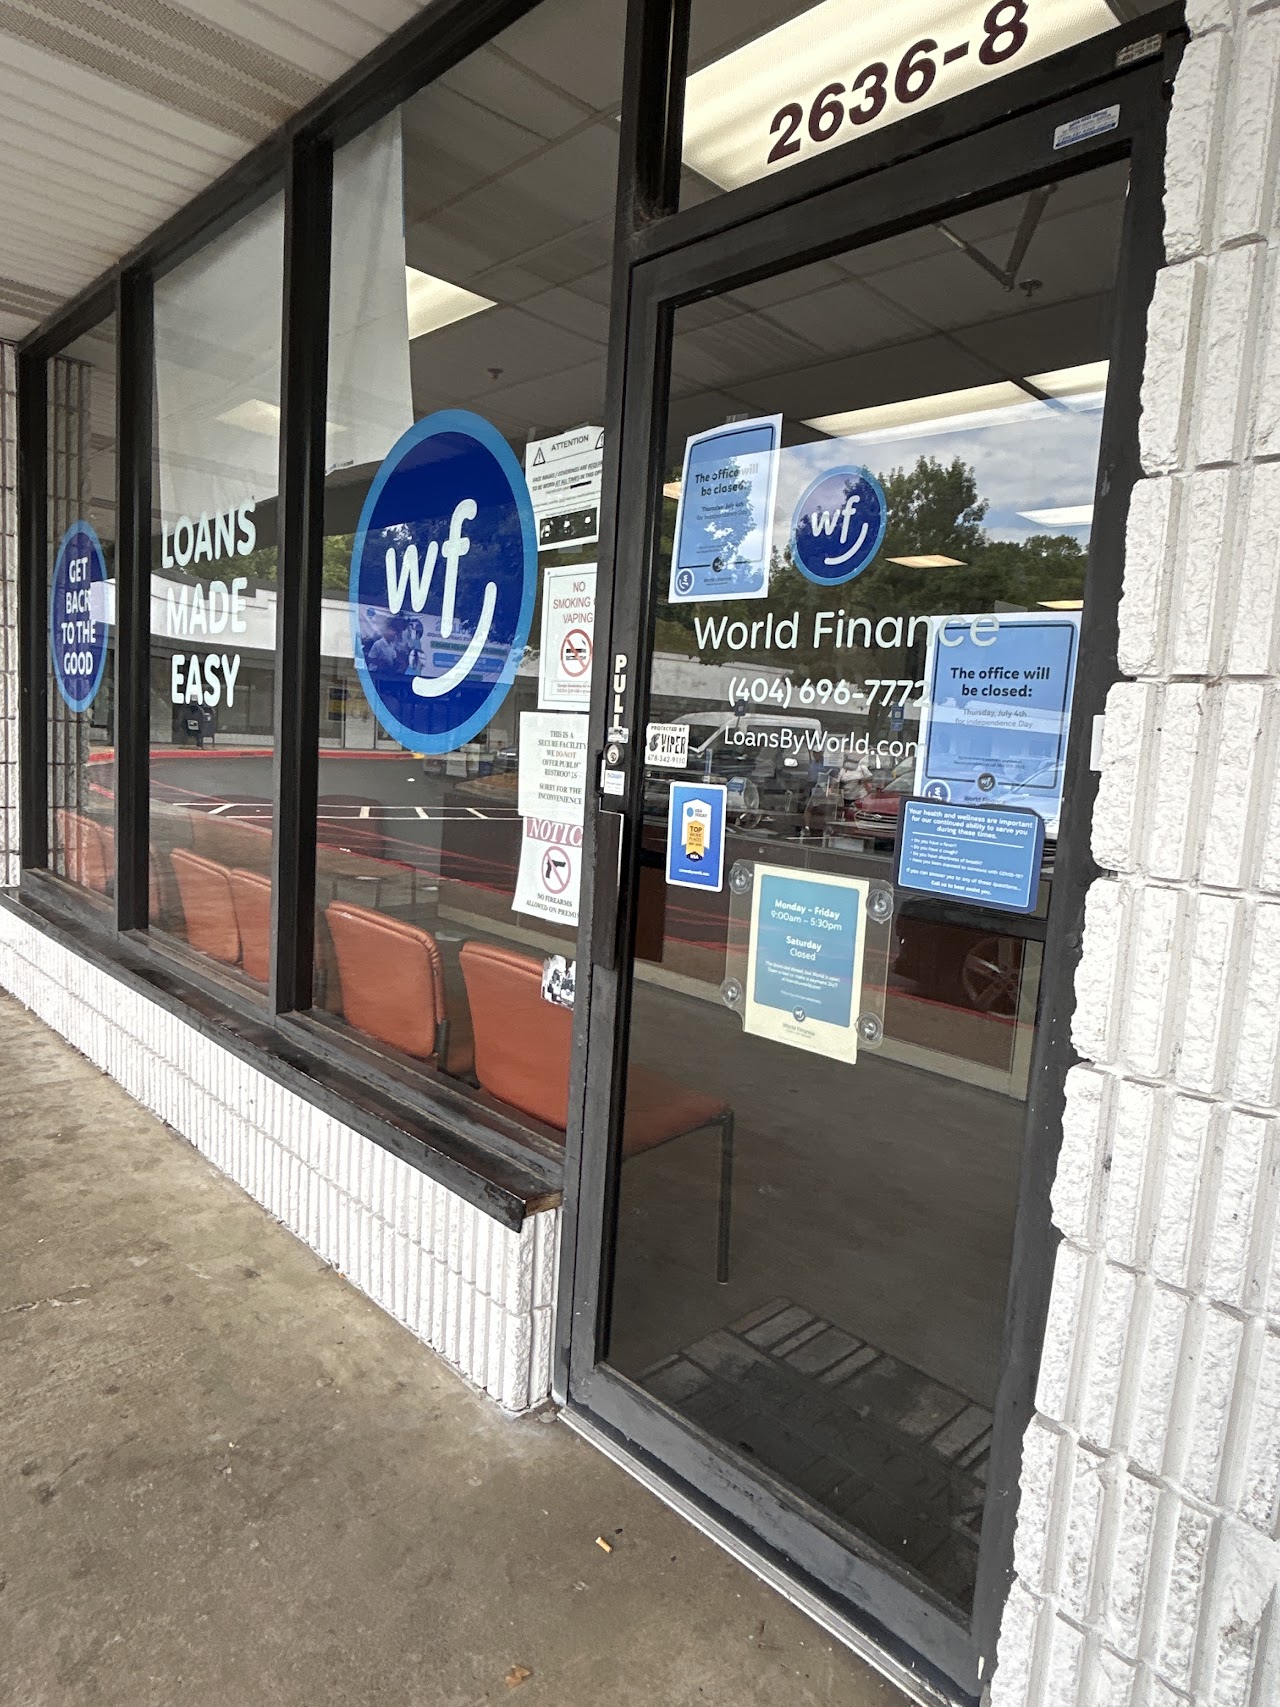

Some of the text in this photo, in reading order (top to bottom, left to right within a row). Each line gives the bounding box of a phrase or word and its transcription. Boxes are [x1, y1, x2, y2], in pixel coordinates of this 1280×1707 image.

[767, 0, 1028, 164] 2636-8
[551, 434, 589, 452] ATTENTION
[695, 464, 758, 483] The office will
[161, 498, 256, 568] LOANS
[69, 557, 88, 583] GET
[573, 581, 585, 592] NO
[66, 589, 92, 614] BACK
[167, 577, 248, 635] MADE
[553, 596, 591, 609] SMOKING
[563, 612, 593, 624] VAPING
[61, 619, 97, 644] TO THE
[694, 609, 999, 650] World Finance
[64, 651, 93, 675] GOOD
[171, 654, 241, 708] EASY
[950, 666, 1050, 680] The office will
[728, 676, 932, 708] (404) 696-7772
[962, 683, 1033, 697] be closed:
[962, 708, 1027, 719] Thursday, July 4th
[1018, 720, 1033, 729] Day
[550, 730, 562, 738] THIS
[560, 741, 588, 750] FACILITY
[661, 733, 686, 754] VIPER
[563, 751, 577, 759] NOT
[556, 785, 568, 793] FOR
[569, 786, 583, 795] THE
[537, 792, 583, 805] INCONVENIENCE
[923, 809, 943, 817] health
[957, 814, 985, 823] wellness
[999, 818, 1033, 828] important
[933, 818, 965, 827] continued
[965, 822, 986, 831] ability
[996, 826, 1014, 834] serve
[529, 817, 583, 846] NOTIC
[690, 825, 702, 833] TOP
[936, 826, 957, 835] during
[977, 831, 997, 839] times.
[526, 899, 548, 911] ALLOWED
[545, 895, 573, 907] FIREARMS
[774, 899, 806, 914] Monday
[814, 906, 840, 920] Friday
[770, 910, 802, 923] 9:00am
[810, 917, 842, 931] 5:30pm
[785, 936, 822, 952] Saturday
[789, 947, 816, 961] Closed
